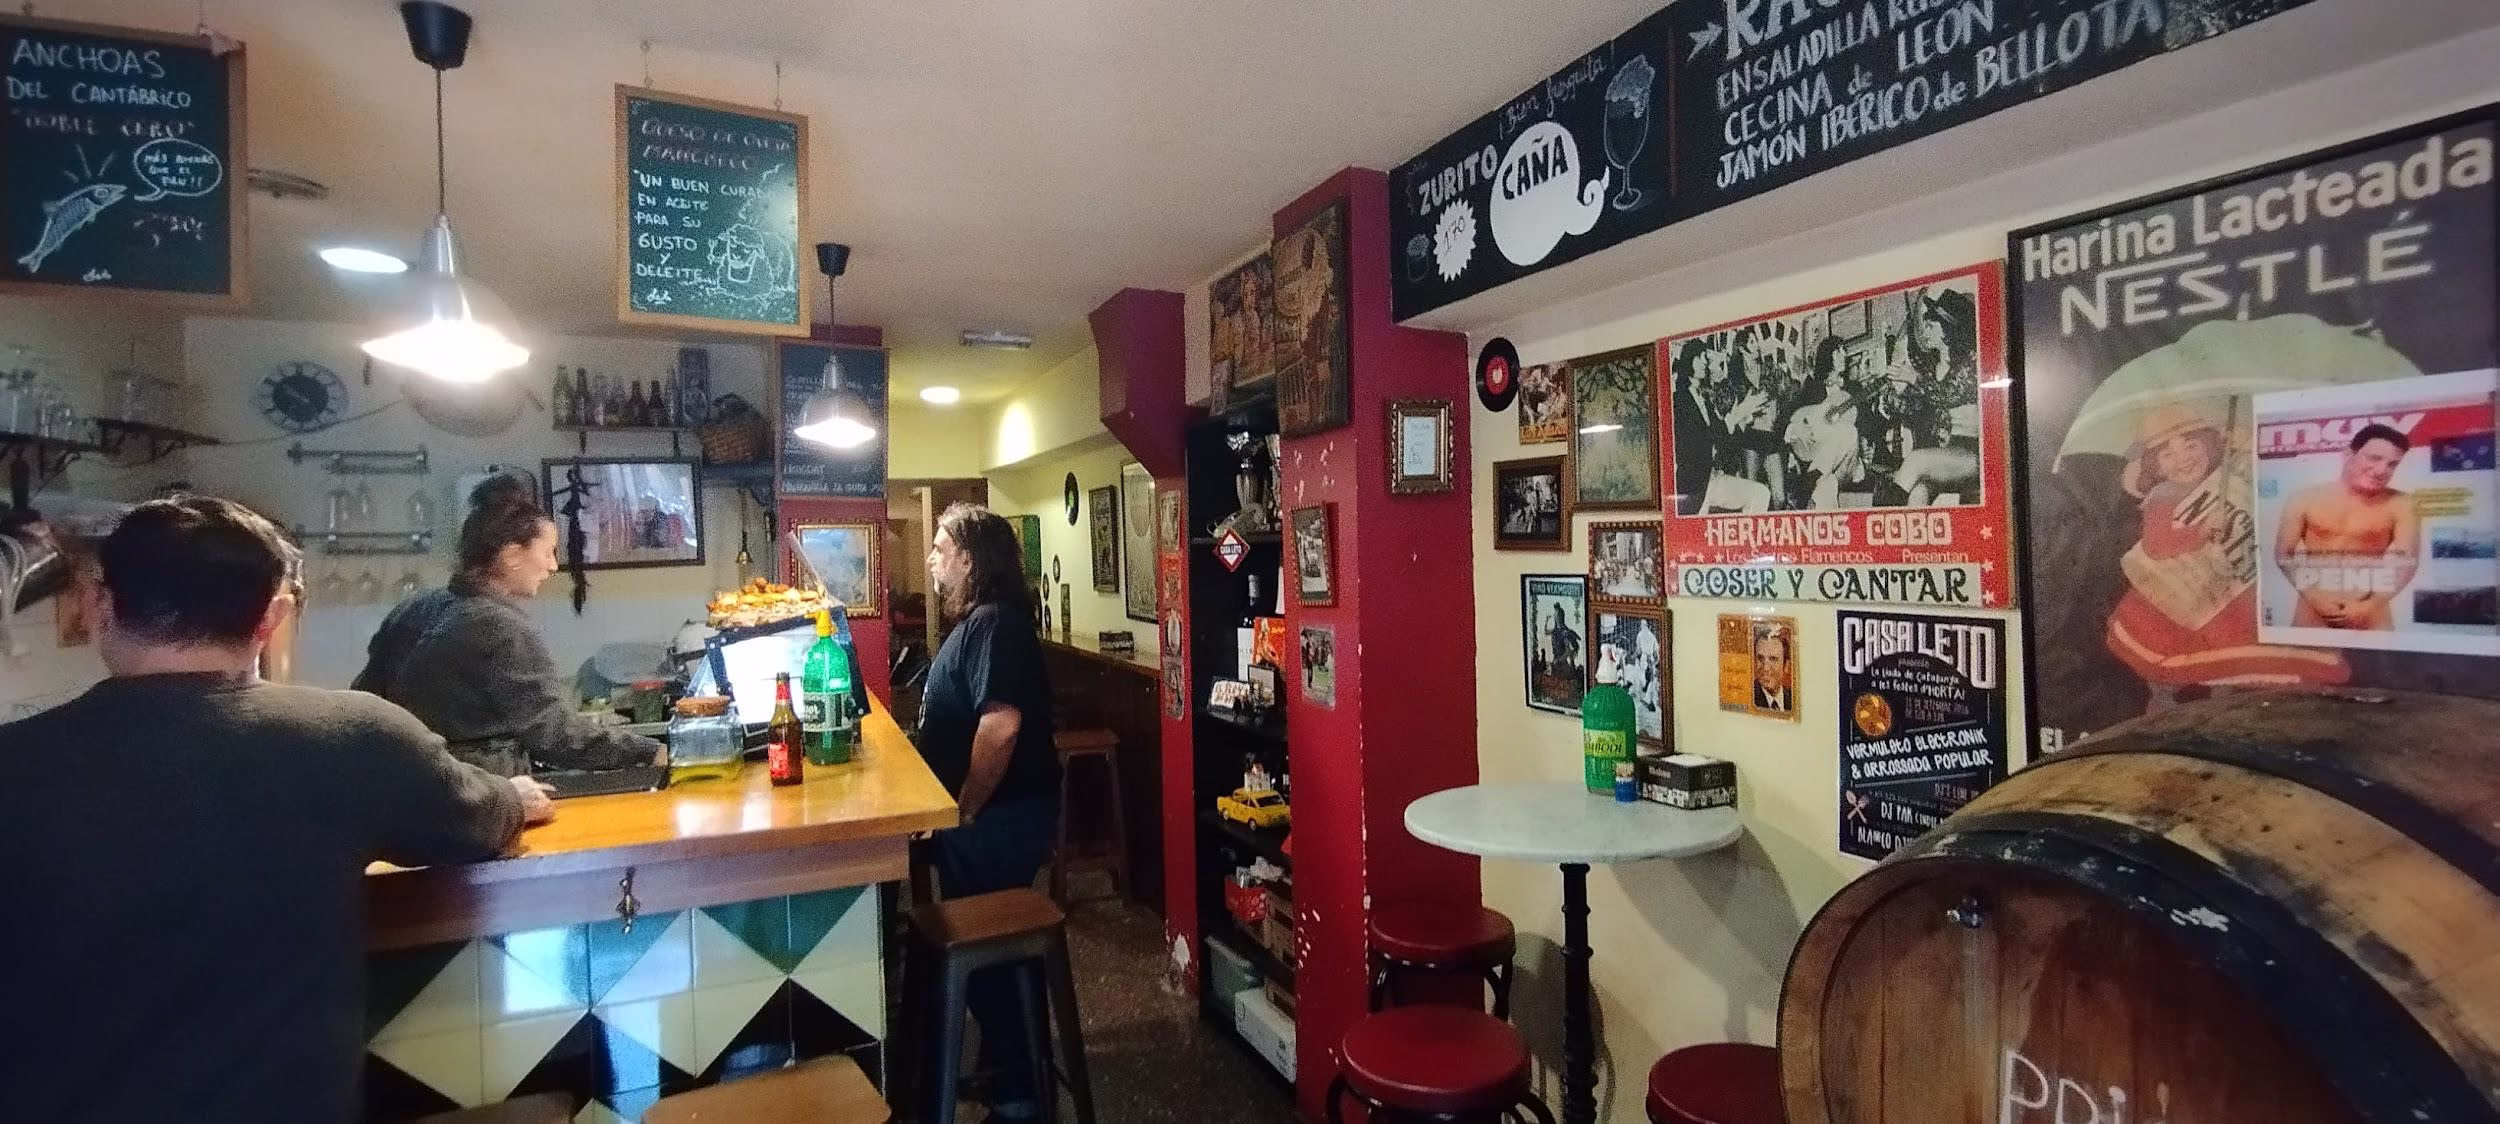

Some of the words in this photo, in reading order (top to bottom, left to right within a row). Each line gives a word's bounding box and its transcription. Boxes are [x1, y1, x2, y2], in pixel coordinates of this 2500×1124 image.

[1726, 0, 1840, 60] RA
[13, 39, 165, 79] ANCHOAS
[1717, 2, 1879, 109] ENSALADILLA
[6, 76, 48, 99] DEL
[1716, 124, 1806, 188] JAMÓN
[1934, 71, 1968, 112] de
[1975, 0, 2163, 98] BELLOTA
[1724, 71, 1833, 146] CECINA
[1848, 64, 1872, 96] de
[1418, 144, 1498, 216] ZURITO
[1502, 135, 1569, 201] CAÑA
[638, 194, 656, 207] EN
[666, 196, 709, 211] ACEITE
[671, 177, 709, 193] BUEN
[720, 184, 775, 201] CURAD
[636, 211, 668, 226] PARA
[682, 216, 701, 228] SU
[2023, 214, 2176, 282] Harina
[2192, 135, 2494, 246] Lacteada
[638, 234, 697, 251] GUSTO
[660, 253, 671, 264] Y
[636, 263, 702, 279] DELEITE
[2060, 209, 2434, 336] NESTLÉ
[1706, 513, 1851, 548] HERMANOS
[1865, 512, 1953, 546] COBO
[1800, 547, 1874, 563] Flamencos
[1902, 547, 1969, 563] Presentan
[1684, 568, 1778, 601] COSER
[1785, 569, 1804, 599] Y
[1818, 566, 1970, 603] CANTAR
[1851, 763, 1862, 779] &
